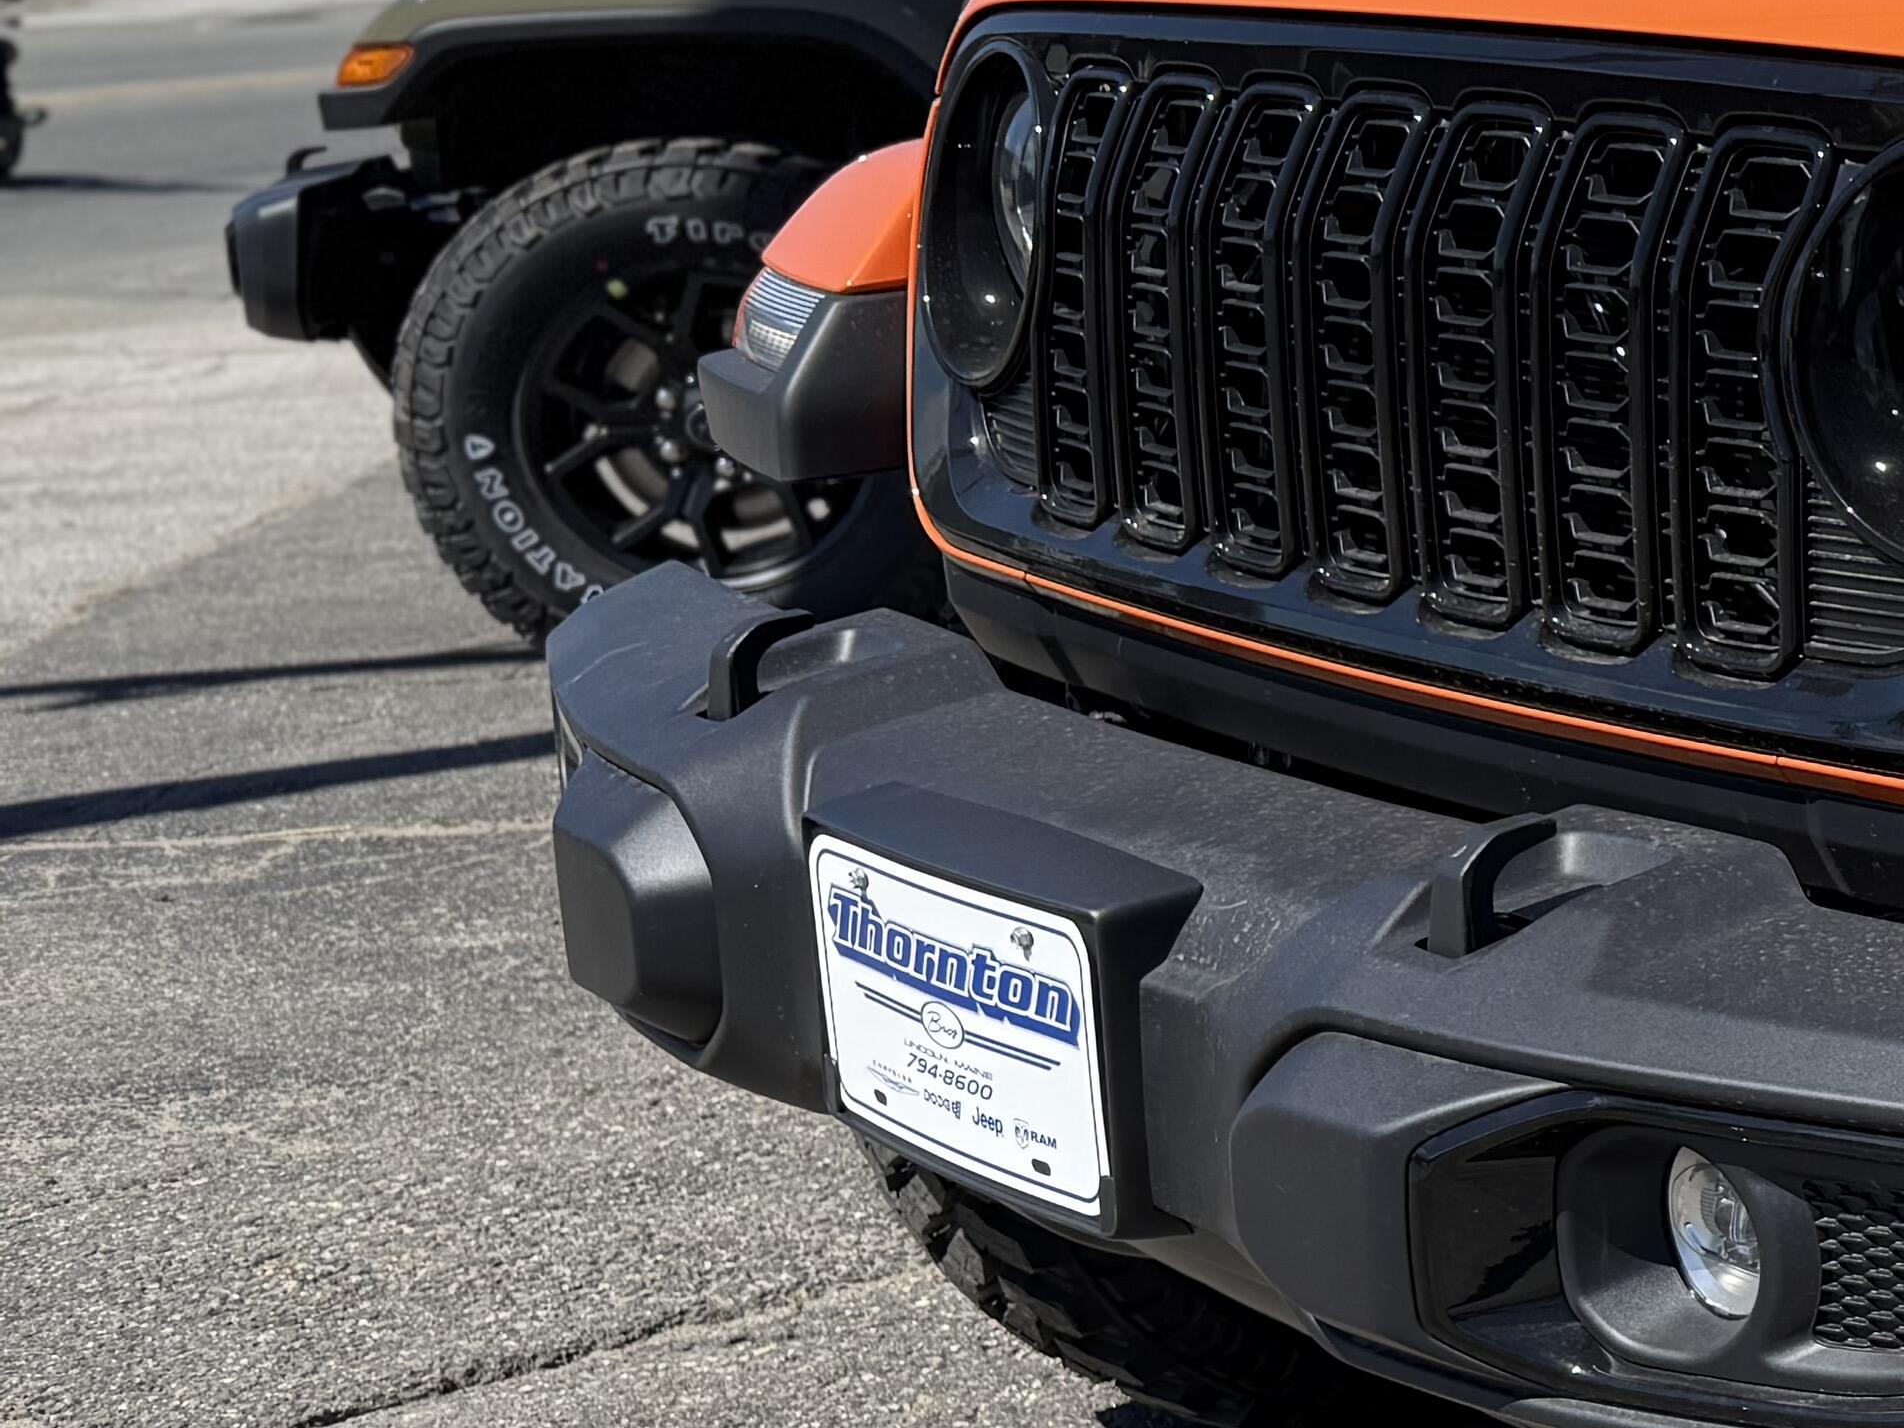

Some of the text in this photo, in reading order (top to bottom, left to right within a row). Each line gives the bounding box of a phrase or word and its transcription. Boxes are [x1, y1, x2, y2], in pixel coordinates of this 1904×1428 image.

[829, 884, 1079, 1044] Thornton
[972, 1106, 1003, 1138] Jeep
[1030, 1130, 1057, 1149] RAM
